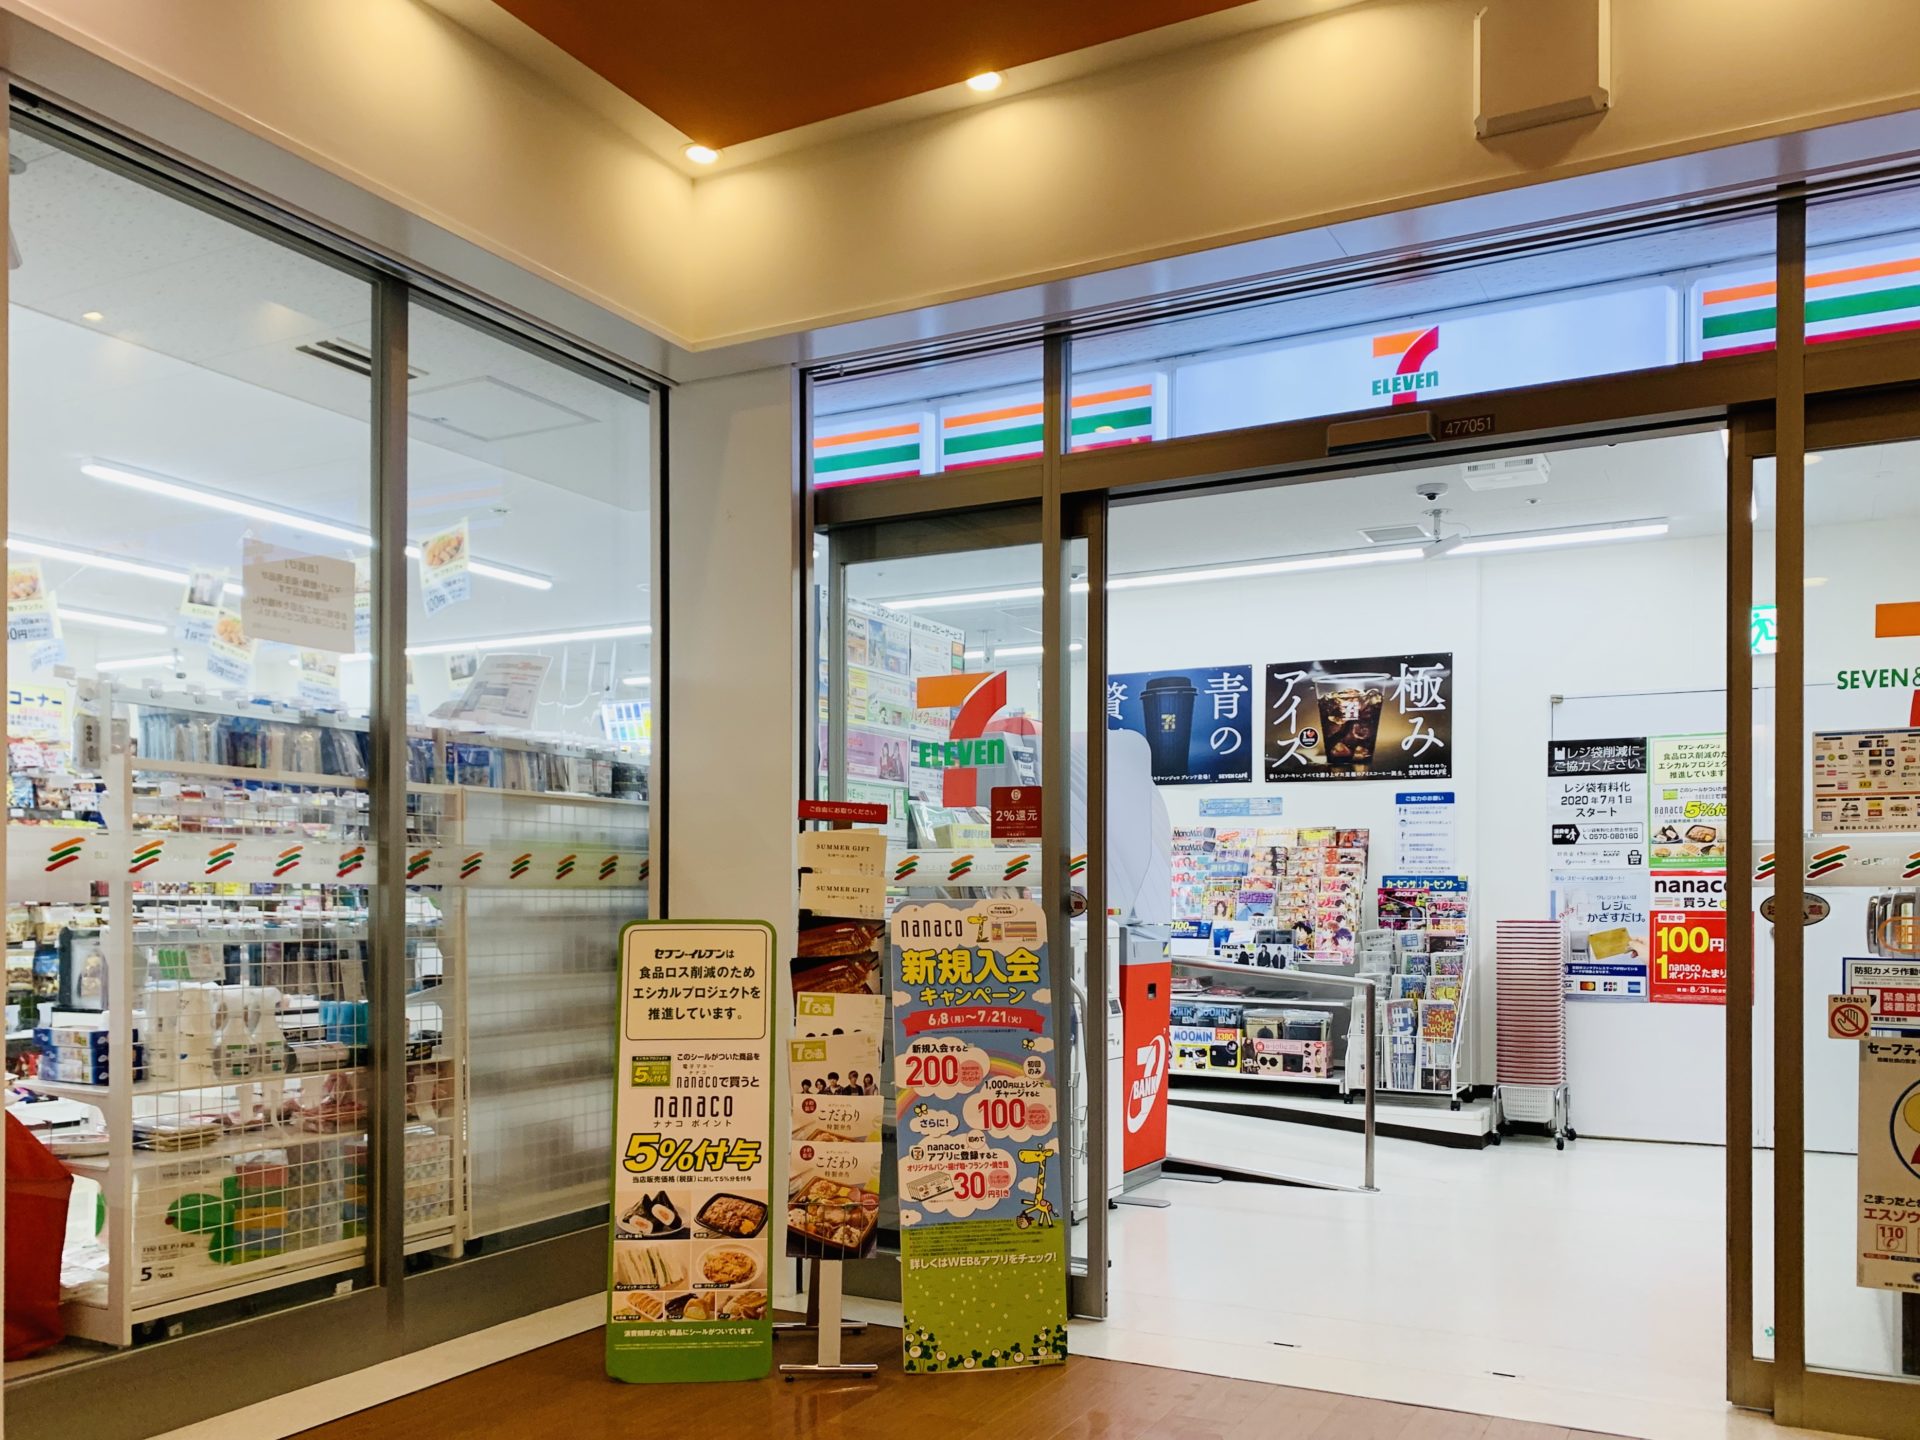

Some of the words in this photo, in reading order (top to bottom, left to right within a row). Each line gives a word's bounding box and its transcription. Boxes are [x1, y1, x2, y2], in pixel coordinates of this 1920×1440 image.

[1445, 416, 1492, 435] 477051
[9, 690, 62, 707] コーナー
[1204, 672, 1248, 755] 青の
[1391, 662, 1446, 757] 極み
[1272, 669, 1308, 768] アイス
[1567, 745, 1640, 759] レジ袋削減に
[1554, 758, 1641, 772] ご協力ください
[1564, 781, 1631, 793] レジ袋有料化
[809, 805, 877, 816] ご自由にお取りください
[995, 810, 1038, 822] 2%還元
[1575, 806, 1617, 817] スタート
[1589, 832, 1639, 840] 0570-080180
[816, 885, 850, 893] SUMMER
[1386, 880, 1417, 889] カーセンサ
[1423, 880, 1458, 889] カーセンサー
[1601, 901, 1632, 911] レジに
[1683, 897, 1718, 908] 買うと
[1587, 912, 1645, 923] かざすだけ。
[901, 919, 963, 938] nanaco
[639, 965, 755, 979] 食品ロス削減のため
[901, 947, 1041, 985] 新規入会
[1668, 963, 1701, 972] nanaco
[1854, 966, 1920, 976] 防犯カメラ作動
[1669, 972, 1701, 980] ポイント
[632, 985, 761, 999] エシカルプロジェクトを
[919, 987, 1026, 1007] キャンペーン
[648, 1007, 742, 1020] 推進しています。
[1173, 1030, 1212, 1042] MOOMIN
[912, 1043, 969, 1054] 新規入会すると
[676, 1053, 760, 1061] このシールがついた商品を
[905, 1054, 959, 1086] 200
[676, 1076, 760, 1089] nanacoで買うと
[985, 1079, 1045, 1089] 1,000円以上レジで
[1133, 1074, 1158, 1099] BANK
[995, 1089, 1041, 1098] チャージすると
[654, 1095, 733, 1118] nanaco
[818, 1108, 860, 1123] こだわり
[978, 1098, 1026, 1129] 100
[653, 1120, 684, 1128] ナナコ
[691, 1119, 732, 1128] ポイント
[919, 1118, 949, 1128] さらに!
[623, 1132, 762, 1174] 5%付与
[927, 1150, 998, 1162] アプリに登録すると
[816, 1155, 858, 1169] こだわり
[953, 1171, 986, 1200] 30
[987, 1190, 1009, 1198] 円引き
[1879, 1226, 1904, 1239] 110
[909, 1252, 1057, 1270] 詳しくはWEB&アプリをチェック!
[140, 1267, 153, 1282] 5
